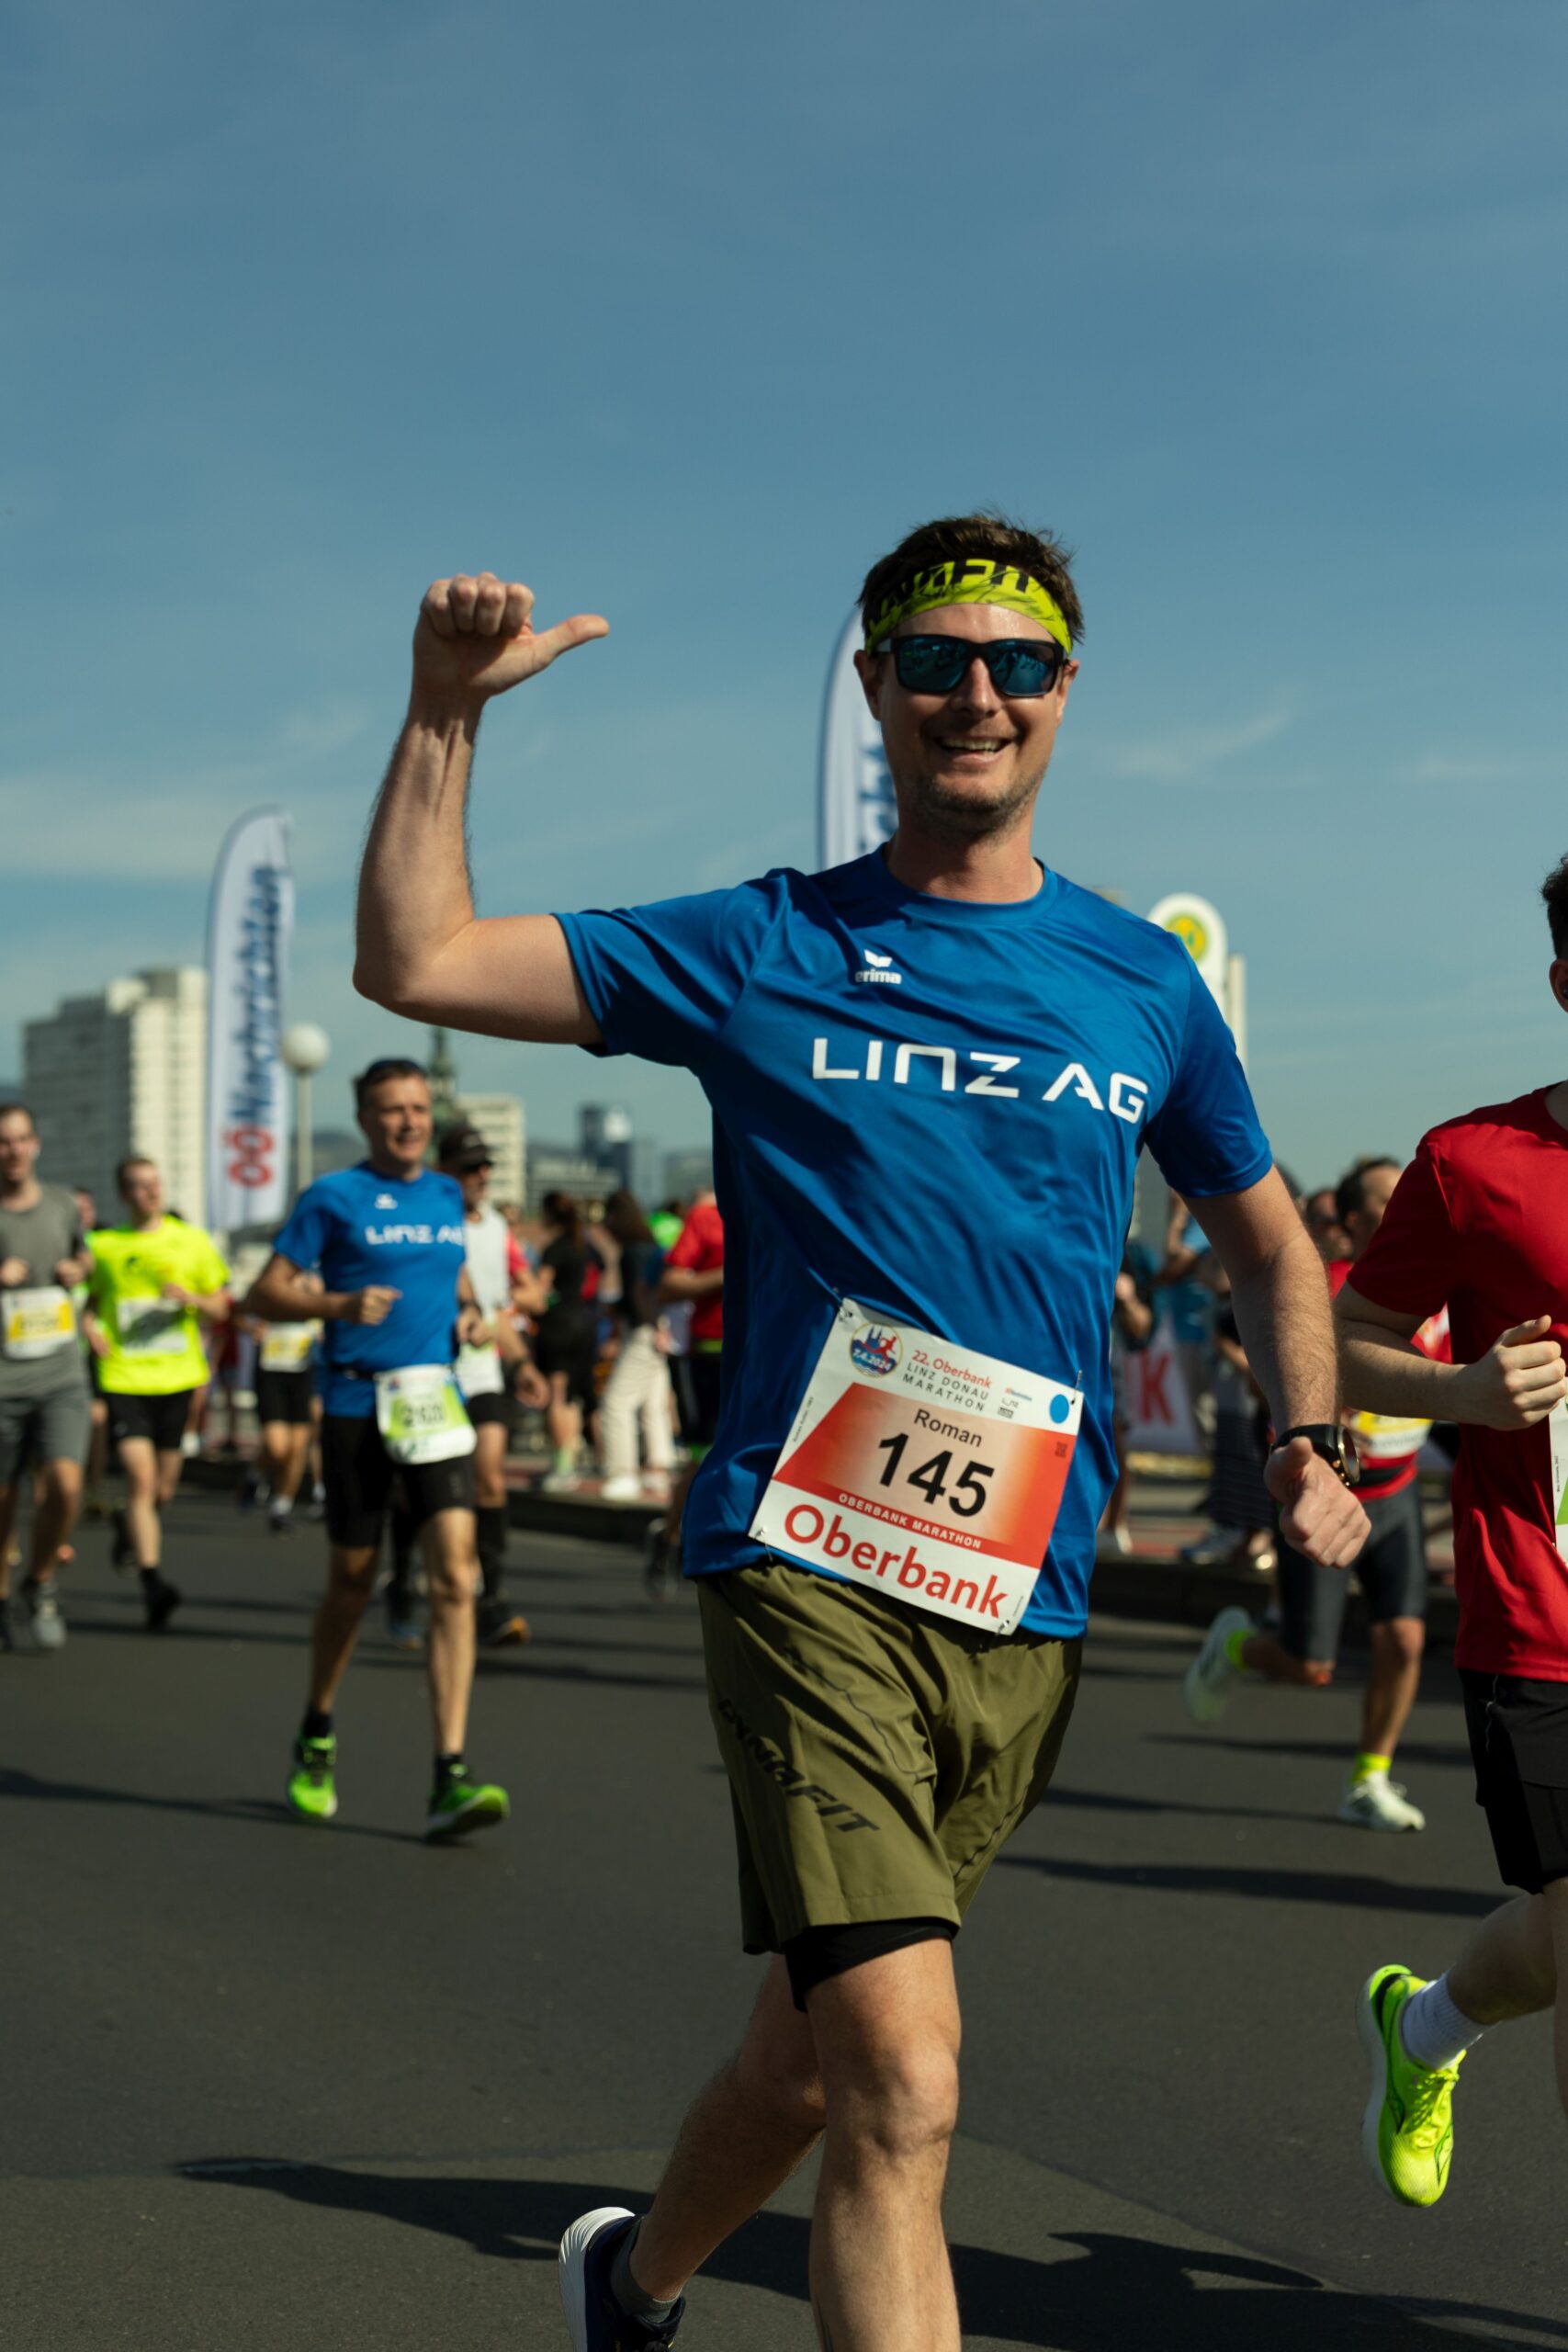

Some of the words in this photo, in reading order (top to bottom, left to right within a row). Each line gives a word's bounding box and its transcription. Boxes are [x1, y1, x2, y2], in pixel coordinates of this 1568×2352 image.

[854, 969, 902, 985] erima
[812, 1037, 1021, 1099] LINZ
[1042, 1062, 1149, 1125] AG
[907, 1363, 936, 1381] LINZ
[942, 1375, 989, 1401] DONAU
[912, 1350, 930, 1367] 22.
[932, 1358, 992, 1389] Oberbank
[902, 1374, 985, 1412] MARATHON
[913, 1408, 983, 1448] Roman
[878, 1432, 995, 1517] 145
[839, 1492, 908, 1526] OBERBANK
[912, 1519, 983, 1550] MARATHON
[784, 1503, 1009, 1619] Oberbank
